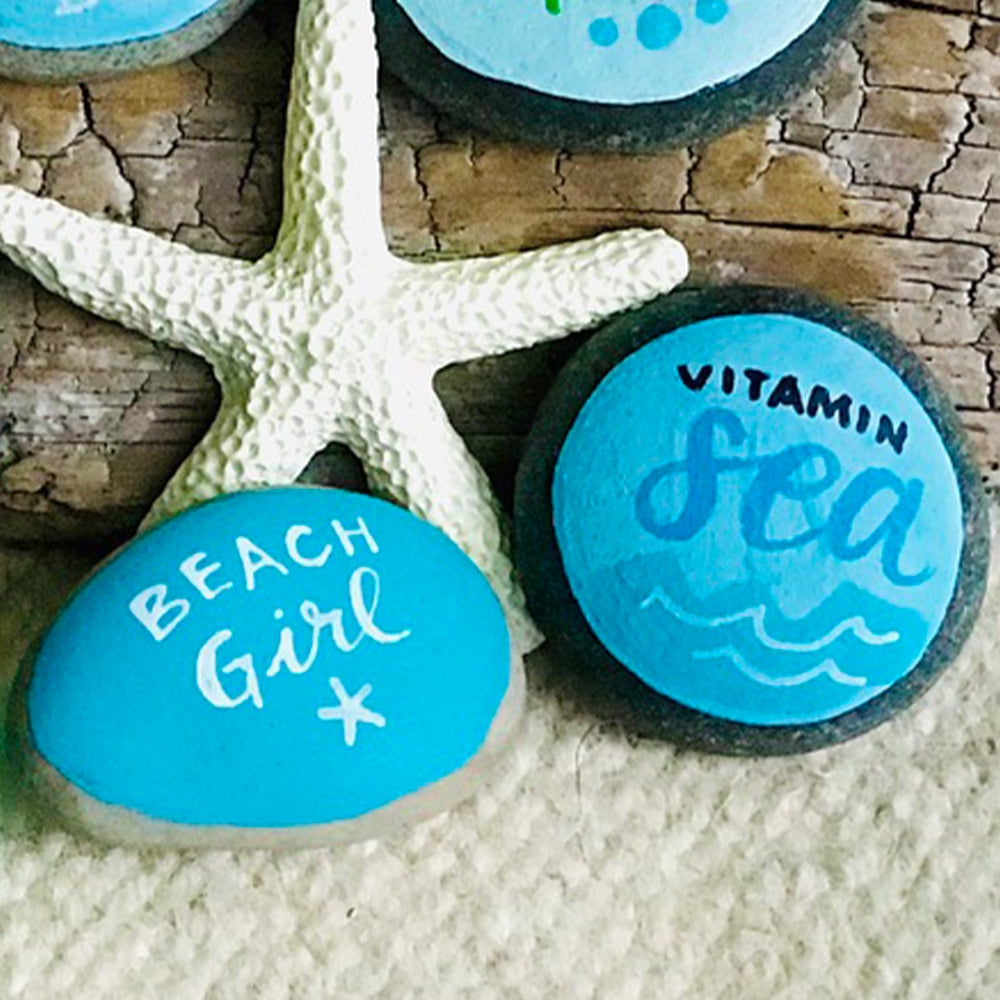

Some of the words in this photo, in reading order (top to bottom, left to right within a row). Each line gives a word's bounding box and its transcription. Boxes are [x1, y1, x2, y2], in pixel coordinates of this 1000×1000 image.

[677, 363, 909, 454] VITAMIN
[129, 516, 379, 642] BEACH
[196, 567, 411, 709] Girl
